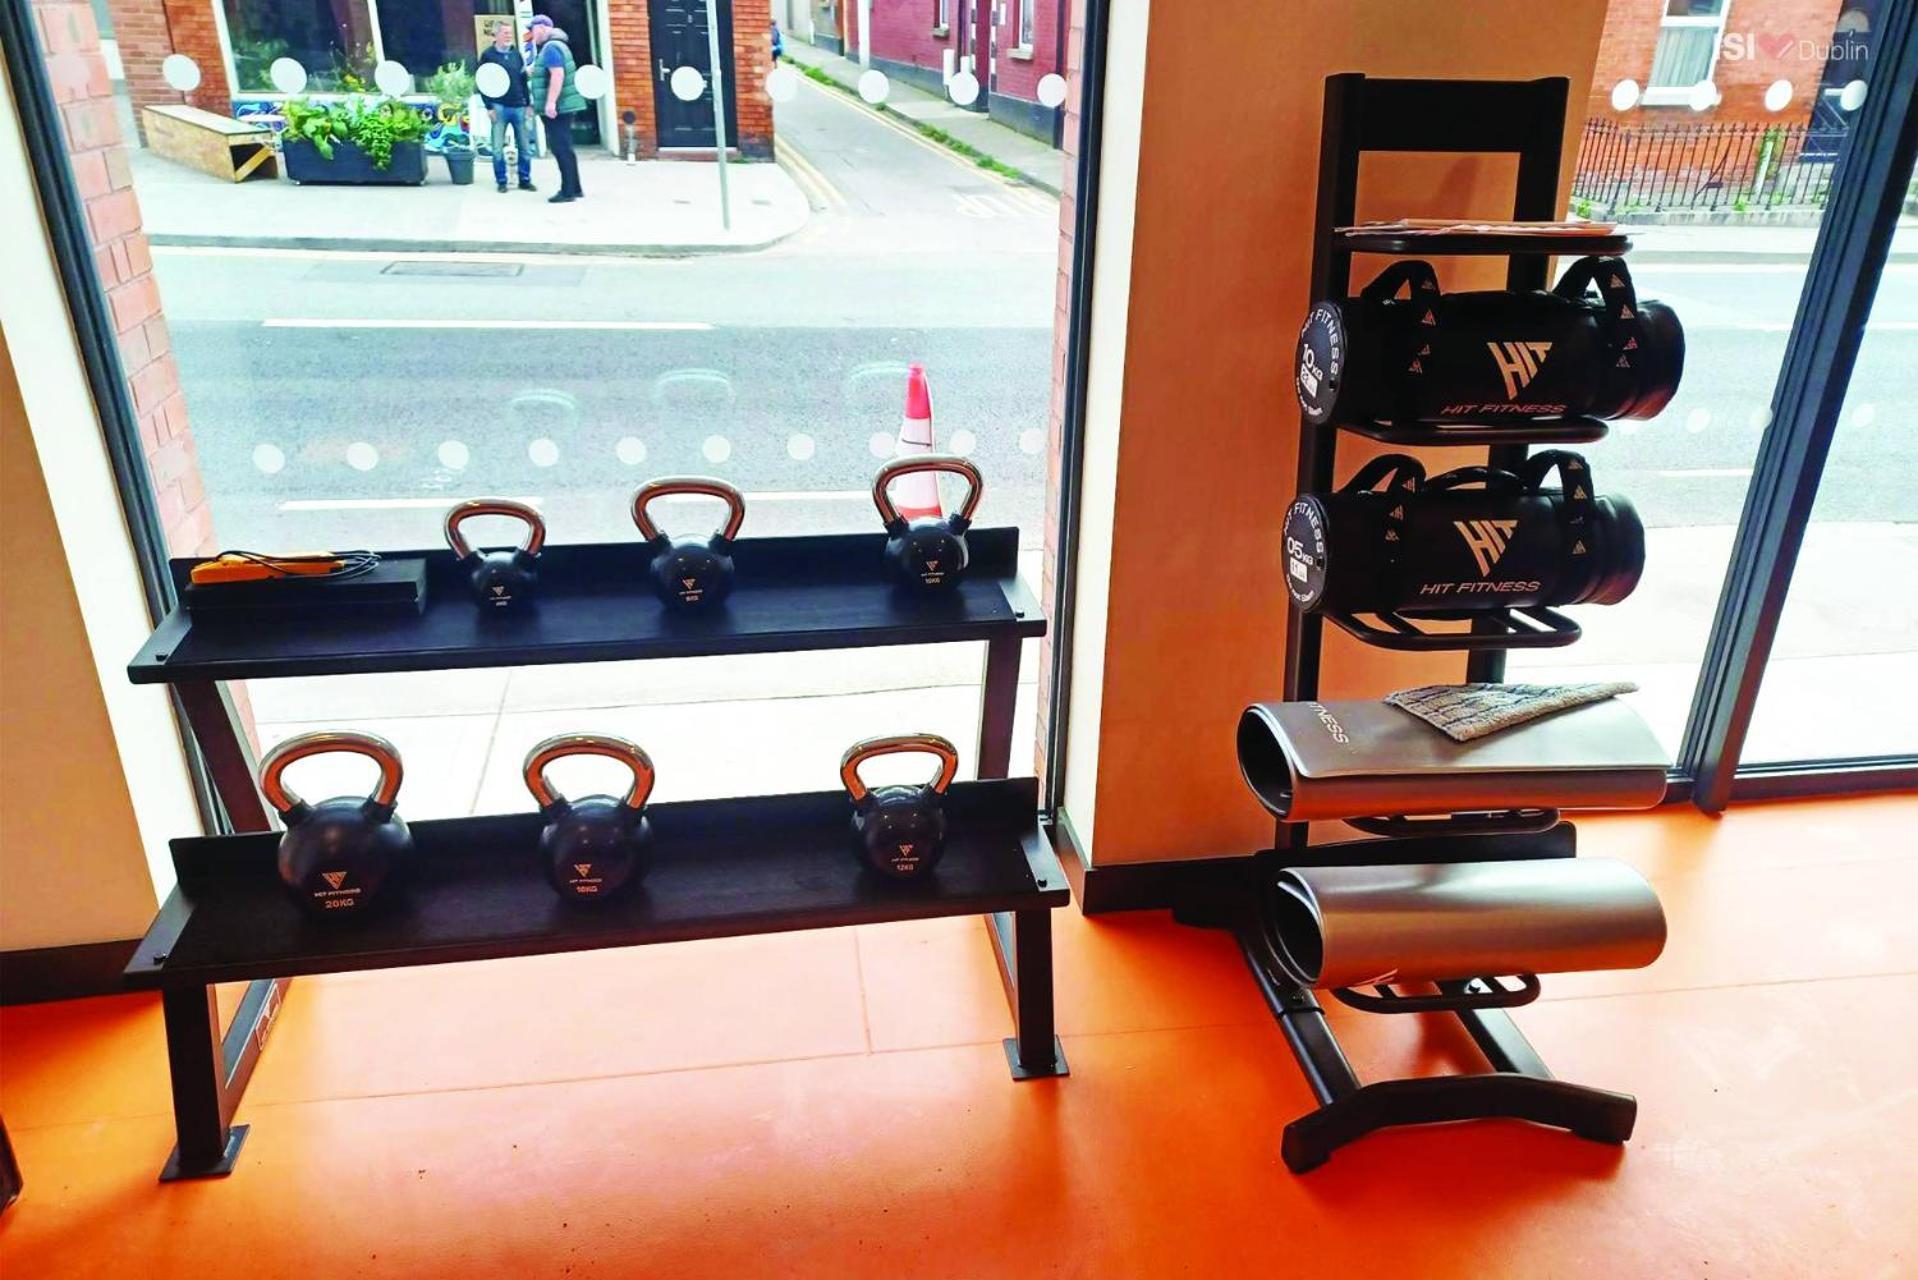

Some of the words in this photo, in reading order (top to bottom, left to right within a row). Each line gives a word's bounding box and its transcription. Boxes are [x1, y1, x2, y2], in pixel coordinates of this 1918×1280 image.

[1315, 308, 1339, 376] FITNESS
[1440, 404, 1478, 415] HIT
[1478, 403, 1567, 414] FITNESS
[1420, 583, 1454, 594] HIT
[1456, 581, 1541, 593] FITNESS
[325, 898, 355, 908] 20KG
